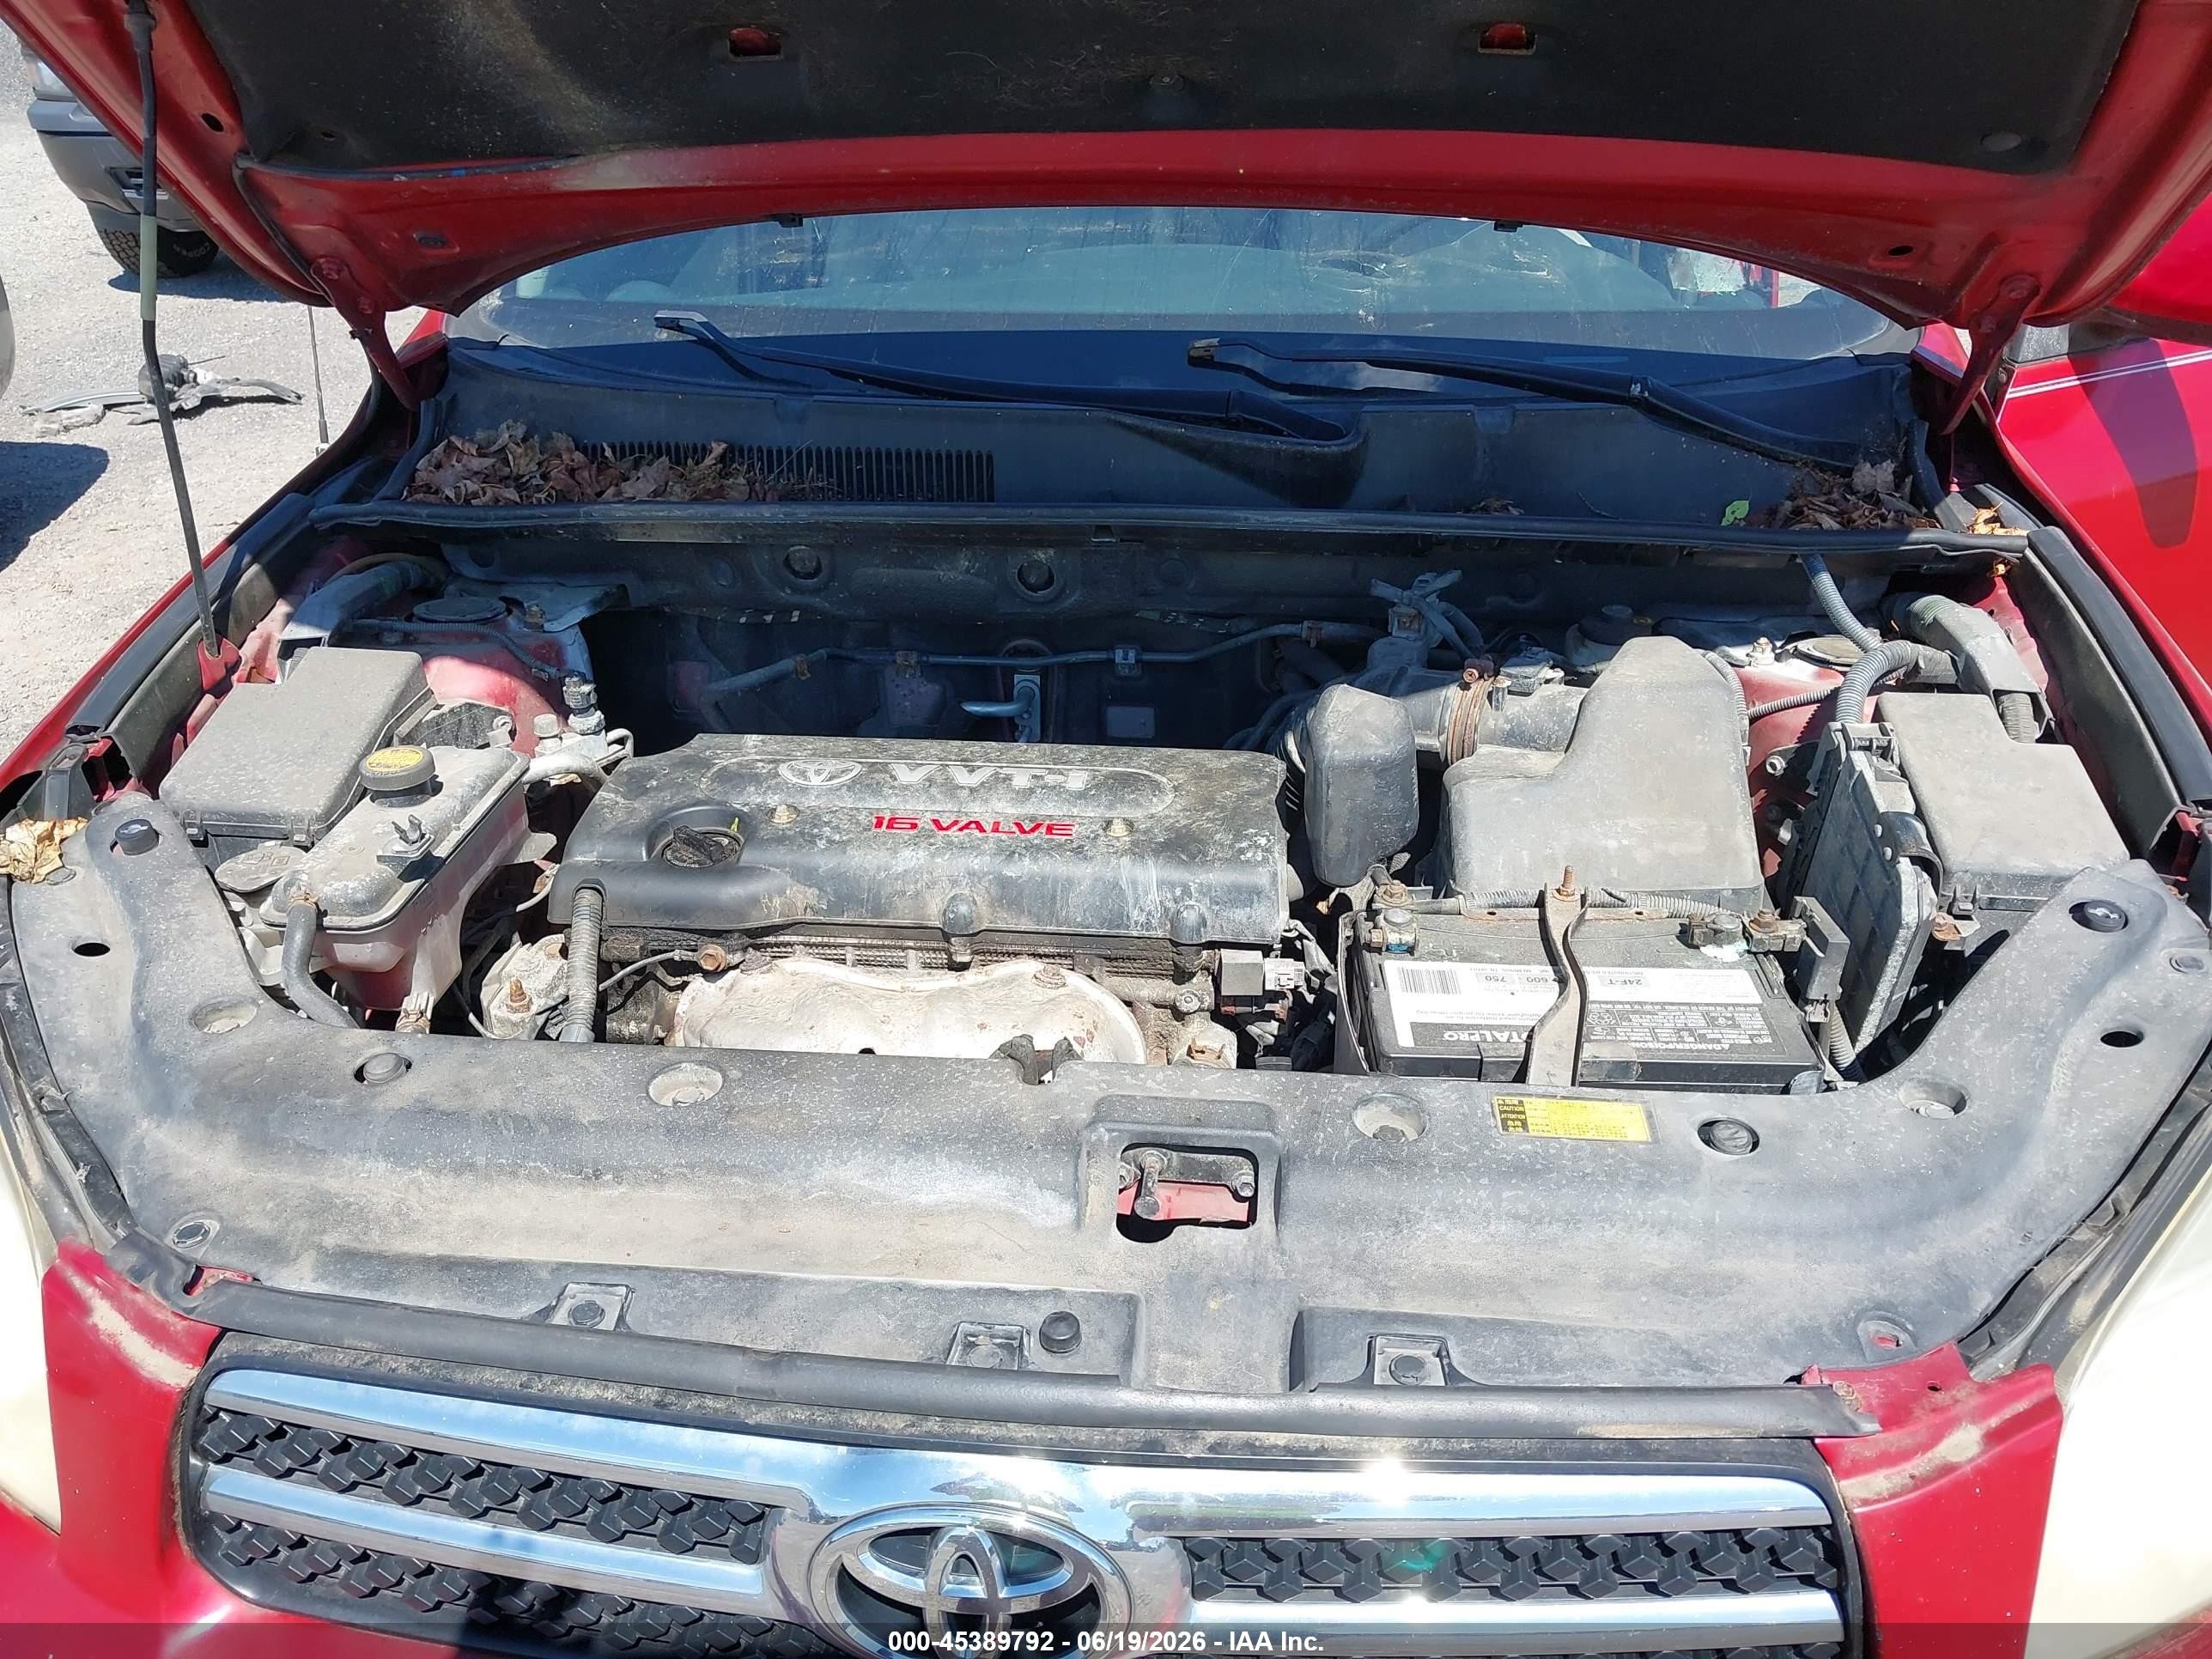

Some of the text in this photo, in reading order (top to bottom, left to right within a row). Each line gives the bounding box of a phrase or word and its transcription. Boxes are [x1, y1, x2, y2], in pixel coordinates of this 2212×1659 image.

[872, 816, 1075, 838] 16 VALVE
[1443, 1030, 1534, 1042] OTALPRO
